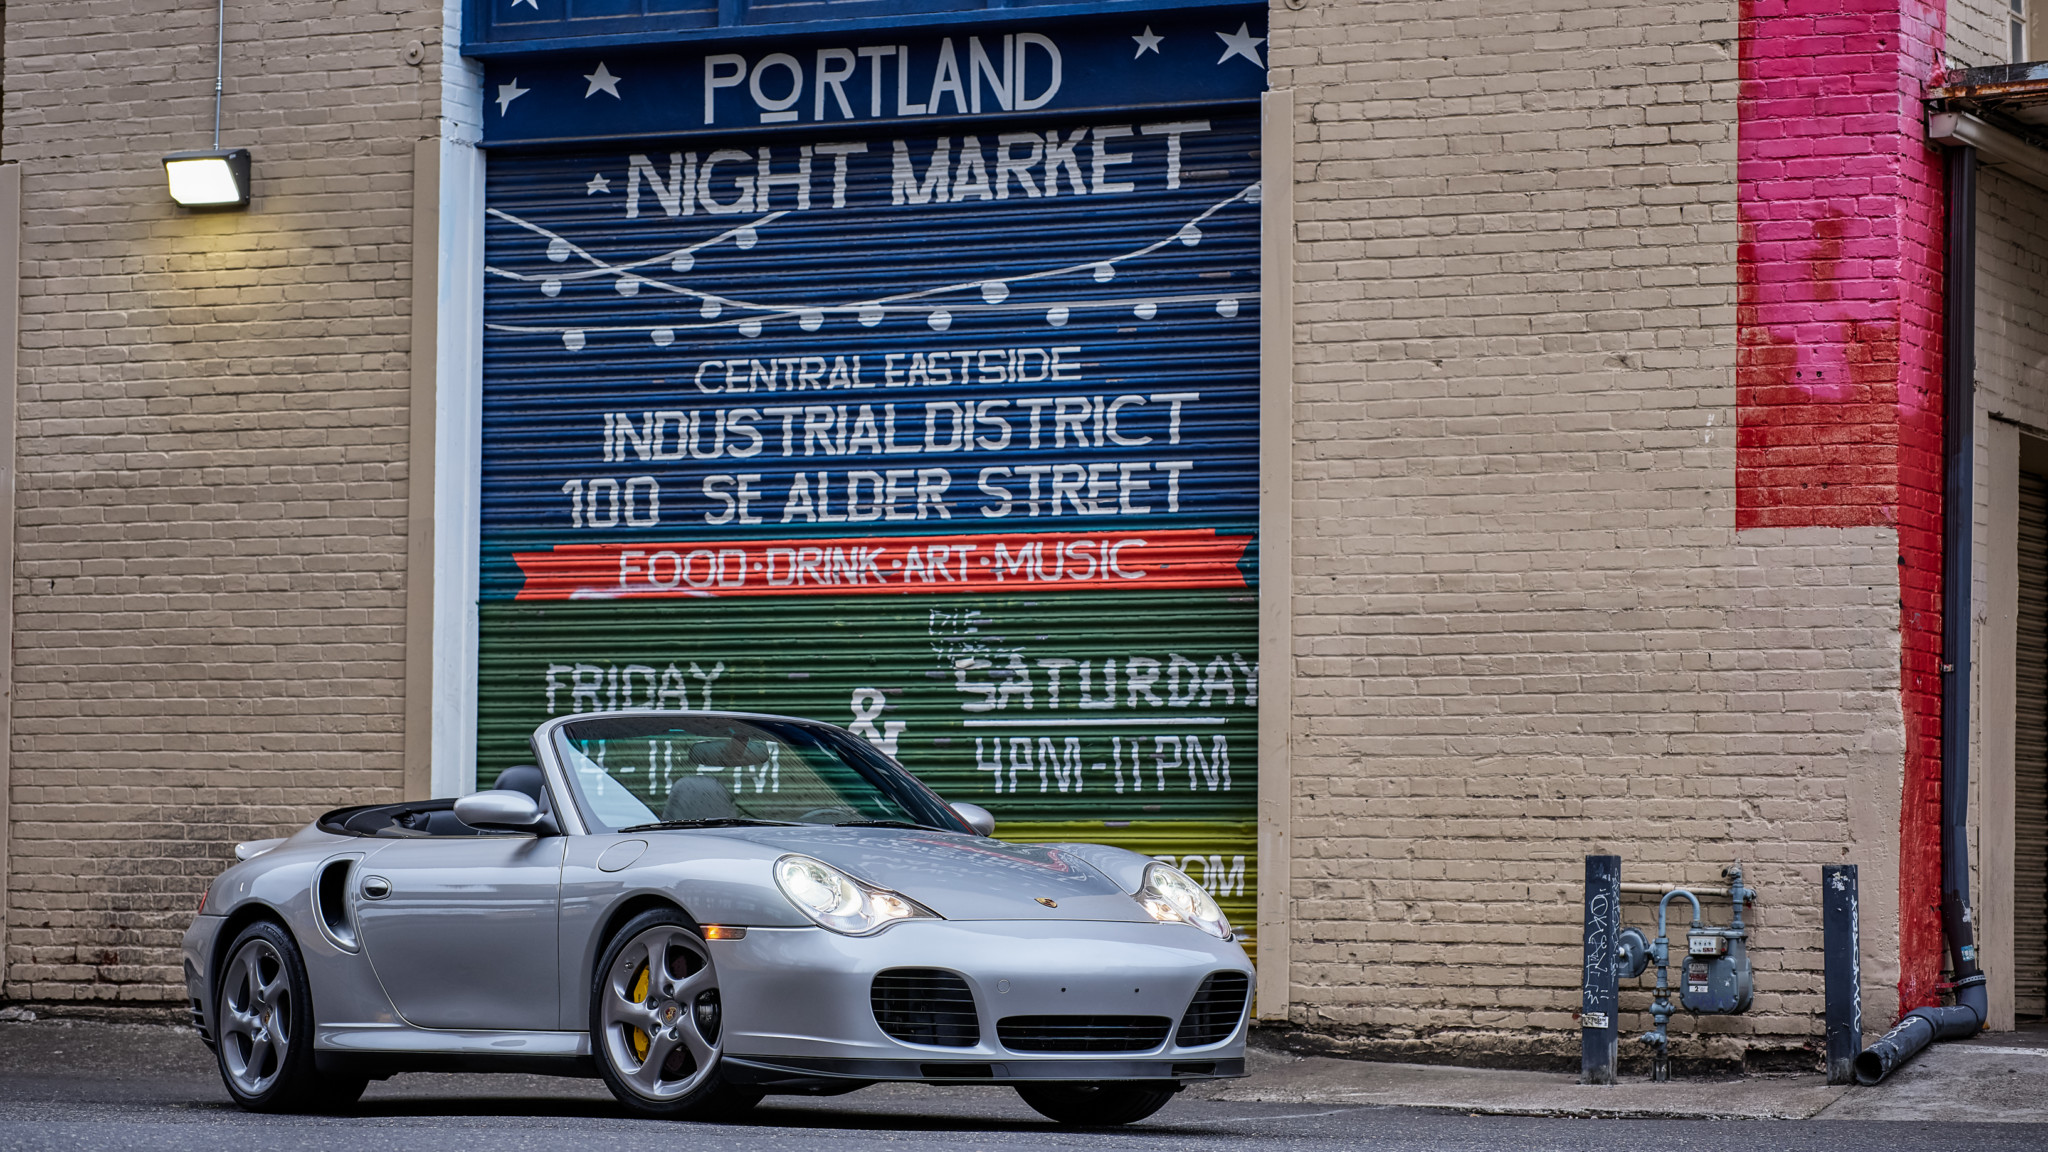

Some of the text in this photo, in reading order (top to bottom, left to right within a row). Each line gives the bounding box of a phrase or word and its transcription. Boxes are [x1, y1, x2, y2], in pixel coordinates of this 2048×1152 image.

[704, 33, 1063, 125] PORTLAND
[625, 120, 1212, 219] NIGHT MARKET
[694, 346, 1083, 394] CENTRAL EASTSIDE
[602, 392, 1200, 463] INDUSTRIAL DISTRICT
[562, 460, 1194, 528] 100 SE ALDER STREET
[546, 661, 725, 714] FRIDAY
[955, 653, 1259, 712] SATURDAY
[848, 687, 907, 768] &
[975, 735, 1231, 794] 4PM-11PM
